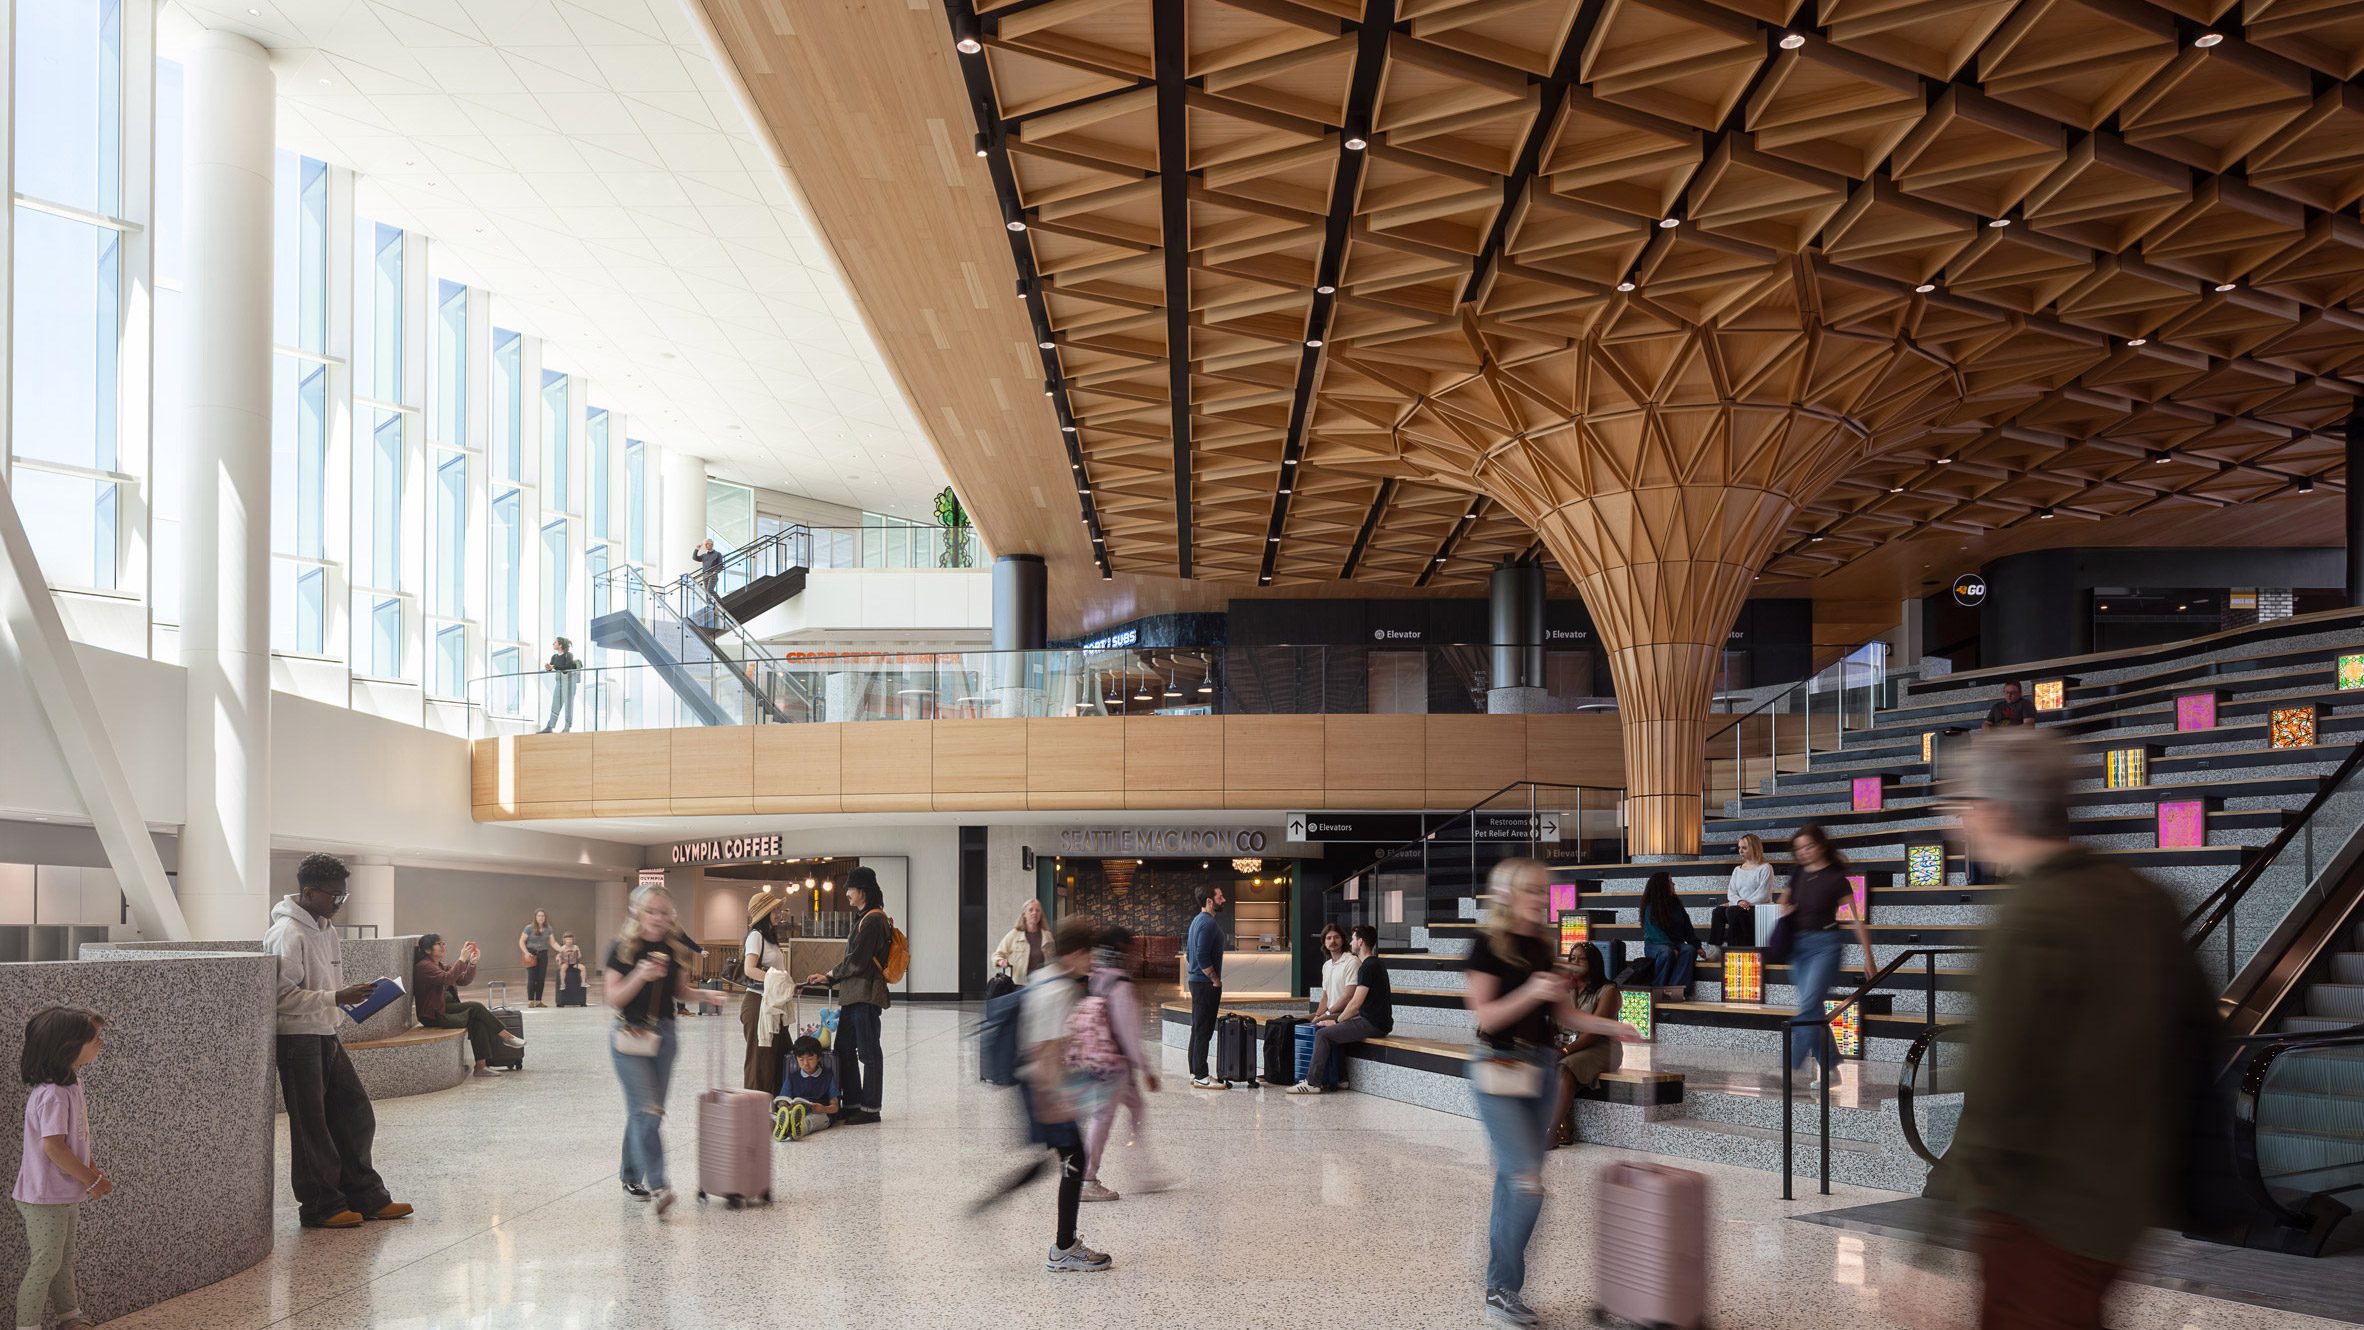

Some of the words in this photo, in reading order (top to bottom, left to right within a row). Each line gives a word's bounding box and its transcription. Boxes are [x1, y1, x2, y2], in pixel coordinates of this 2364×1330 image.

[1967, 584, 1985, 596] GO
[1112, 629, 1137, 648] SUBS
[1387, 630, 1421, 639] Elevator
[1552, 630, 1587, 639] Elevator
[1490, 817, 1528, 826] Restrooms
[1319, 823, 1352, 832] Elevators
[1475, 829, 1487, 838] Pet
[1489, 829, 1509, 838] Relief
[1511, 829, 1528, 838] Area
[1060, 830, 1131, 852] SEATTLE
[1136, 830, 1231, 852] MACARON
[1236, 830, 1267, 852] CO
[672, 840, 721, 863] OLYMPIA
[724, 835, 780, 859] COFFEE
